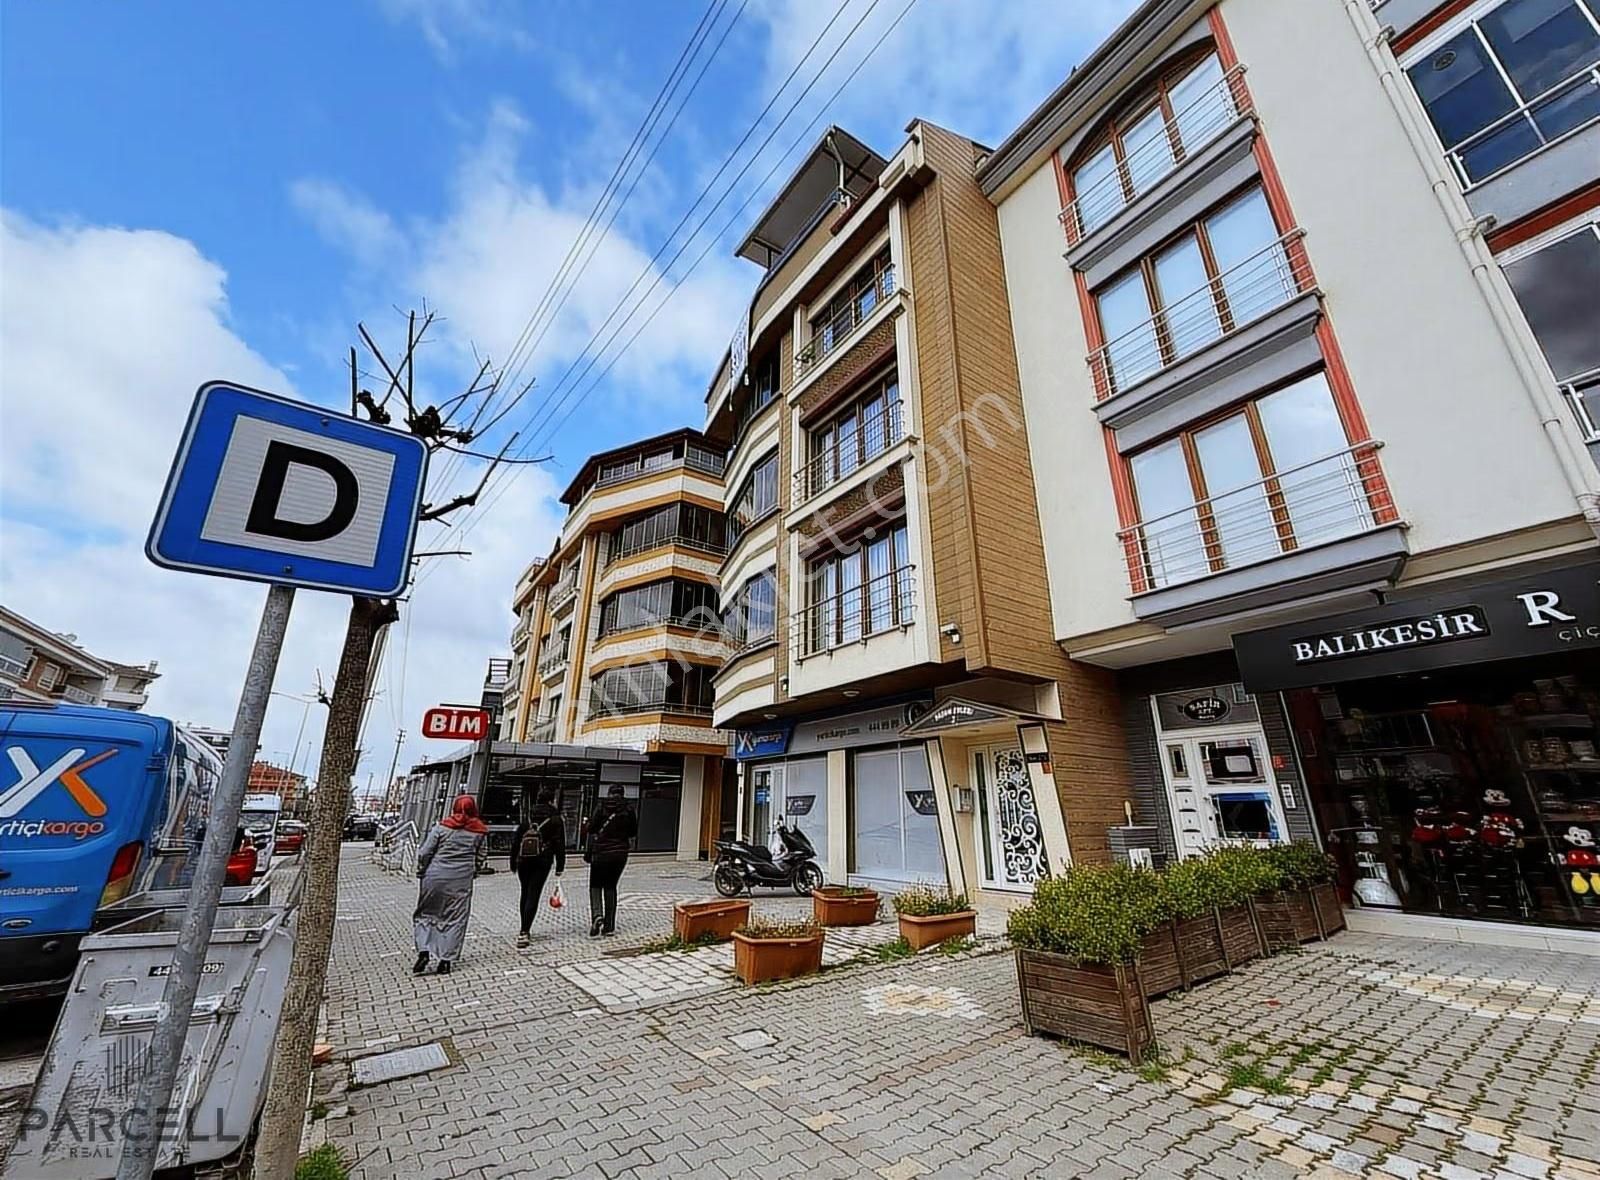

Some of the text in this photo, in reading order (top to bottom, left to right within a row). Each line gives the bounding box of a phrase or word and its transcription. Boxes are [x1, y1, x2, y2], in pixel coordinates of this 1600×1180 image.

[245, 439, 360, 542] D
[1292, 613, 1485, 661] BALIKESİR
[429, 710, 481, 734] BİM
